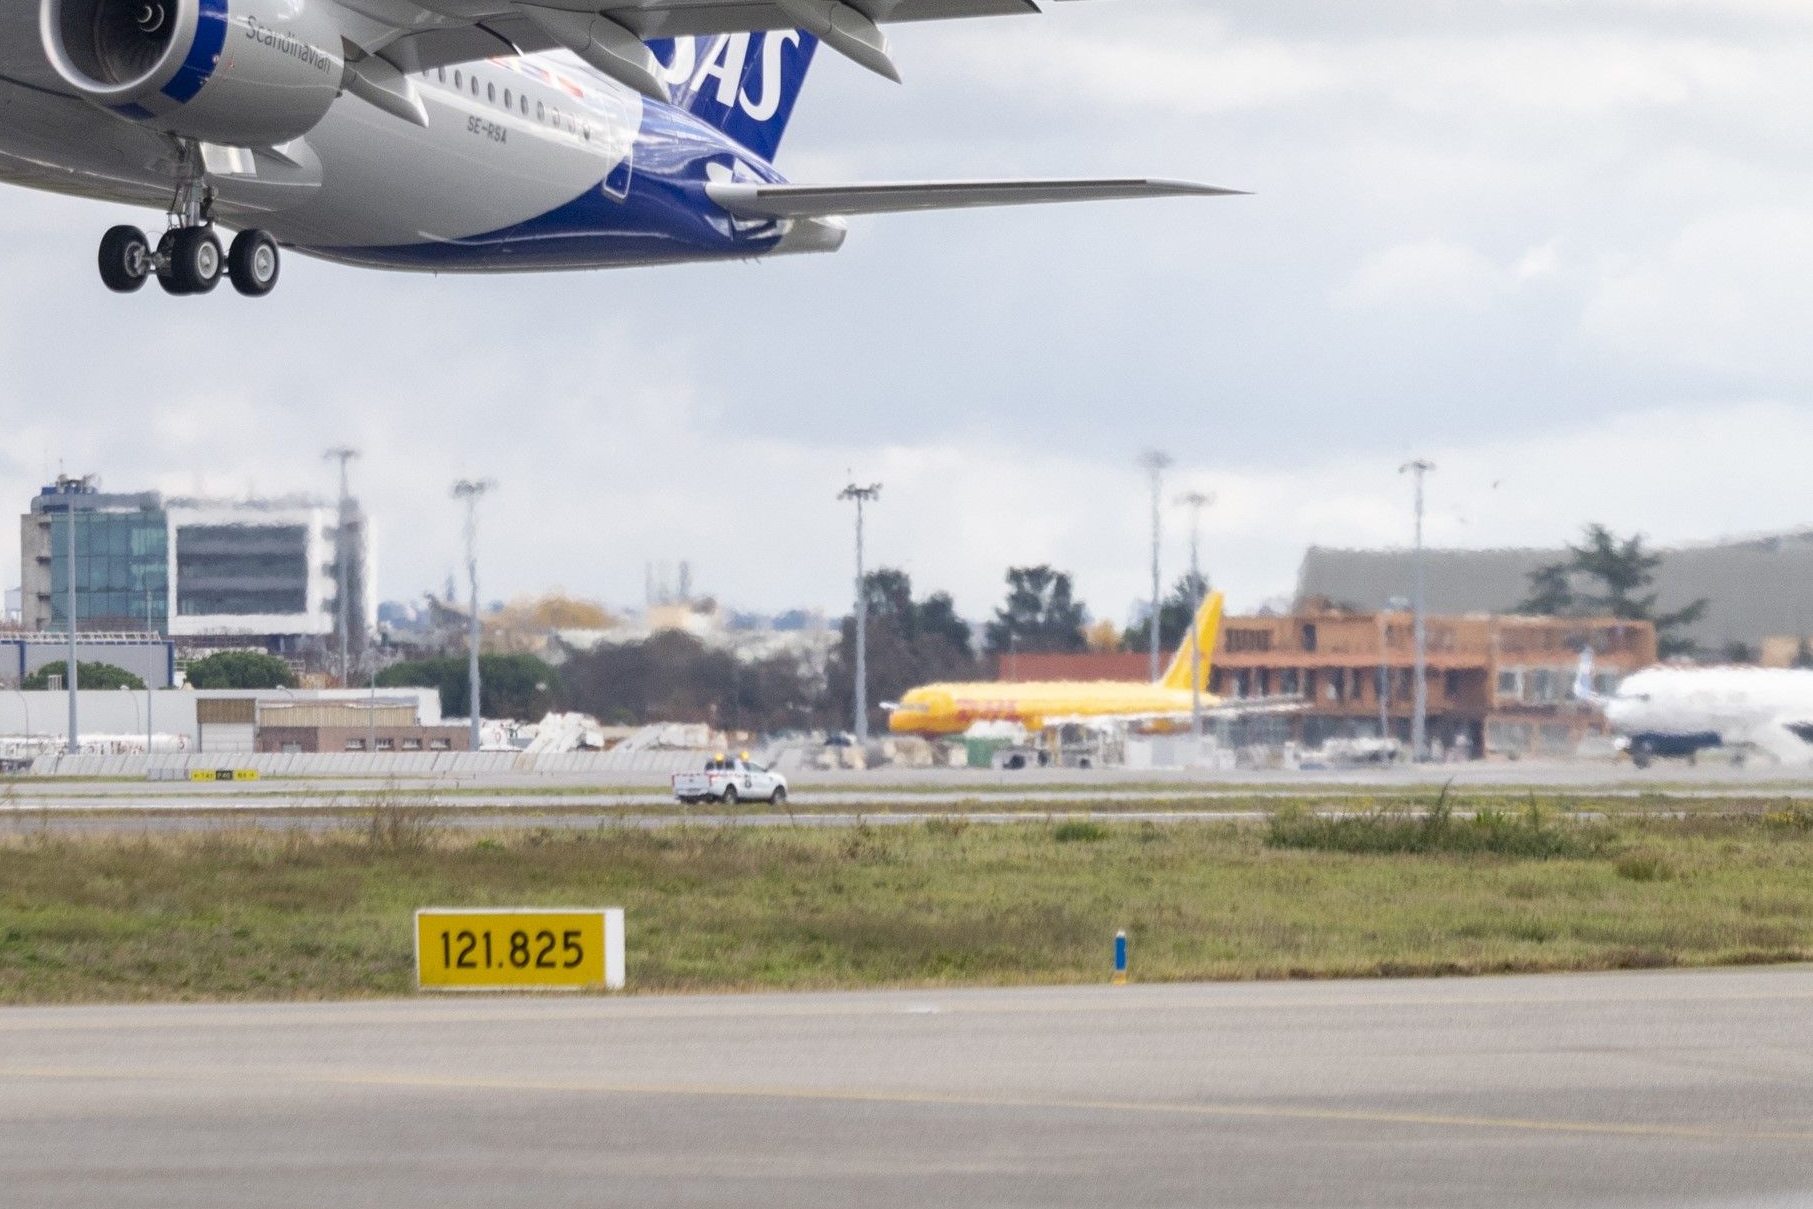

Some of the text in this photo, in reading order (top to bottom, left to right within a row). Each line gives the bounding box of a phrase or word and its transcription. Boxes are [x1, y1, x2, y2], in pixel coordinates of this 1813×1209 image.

[245, 15, 331, 73] Scandinavian
[467, 115, 507, 144] SE-RSA
[441, 930, 584, 969] 121.825
